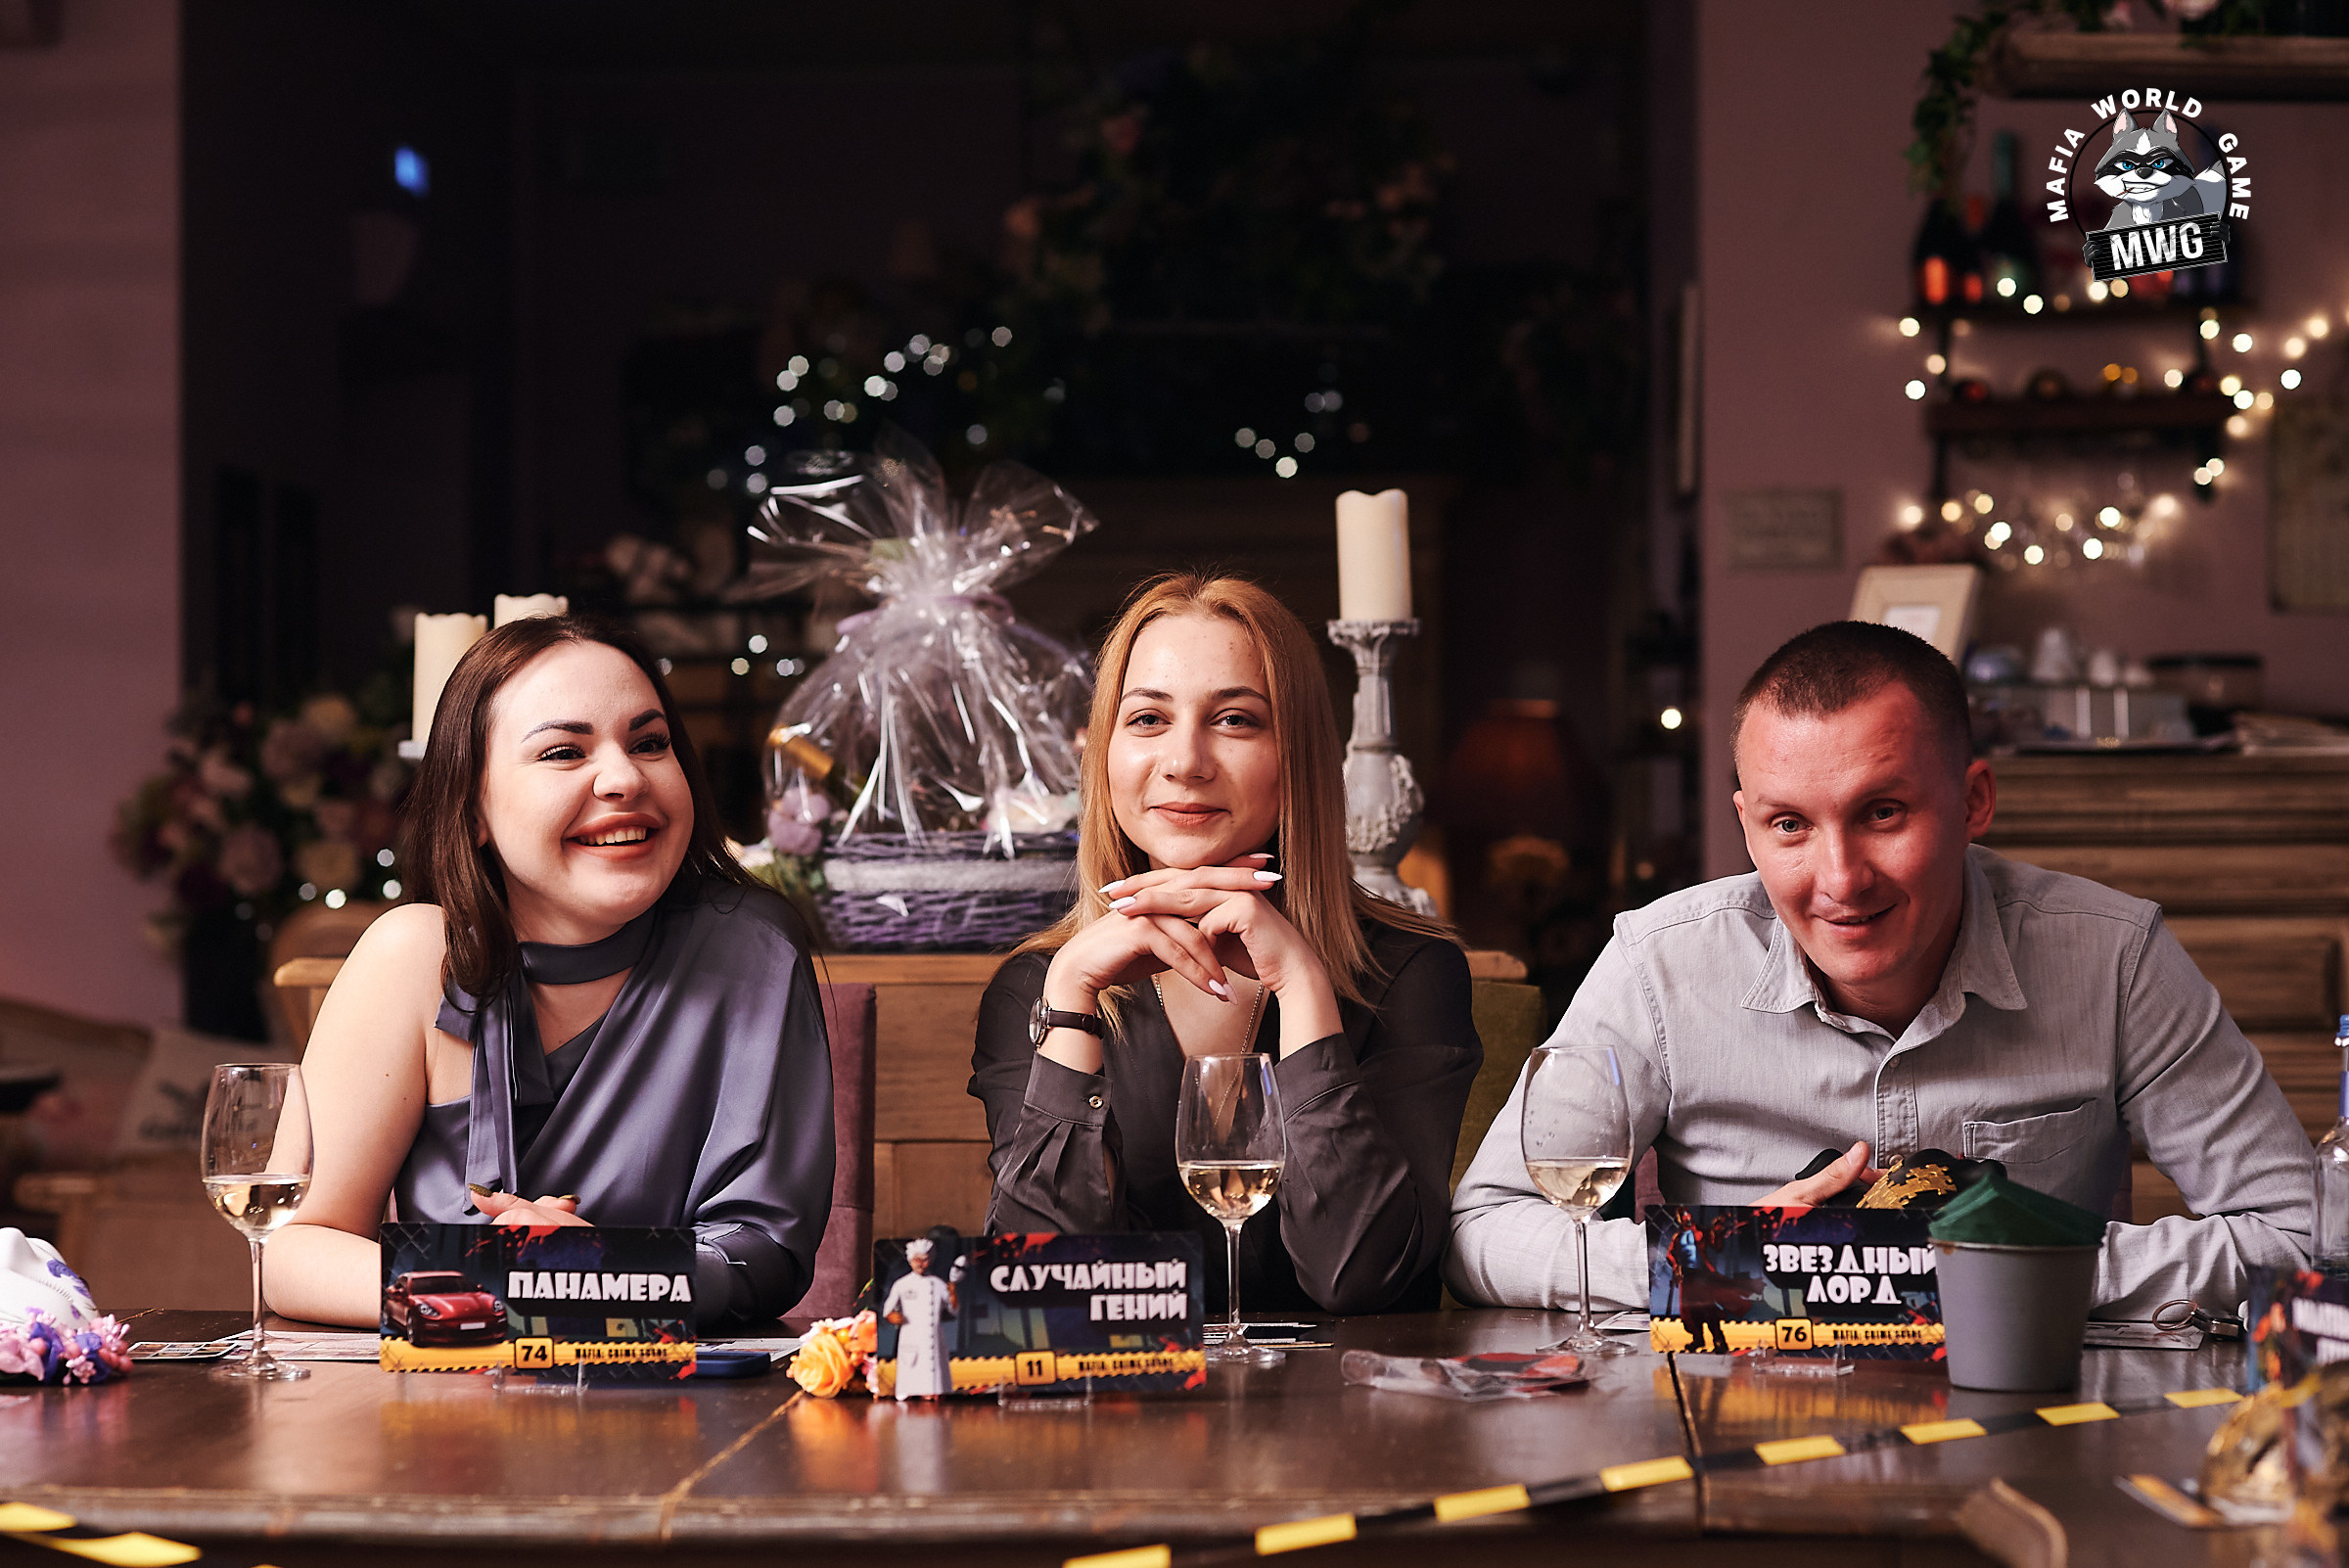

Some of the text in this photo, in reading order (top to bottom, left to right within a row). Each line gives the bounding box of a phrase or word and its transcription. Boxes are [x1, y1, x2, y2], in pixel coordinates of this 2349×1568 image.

[507, 1271, 692, 1303] ПАНАМЕРА
[990, 1258, 1187, 1292] СЛУЧАЙНЫЙ
[1806, 1274, 1903, 1305] ЛОРД
[1089, 1289, 1188, 1321] ГЕНИЙ
[1780, 1325, 1808, 1342] 76
[521, 1345, 548, 1361] 74
[1026, 1360, 1042, 1377] 11
